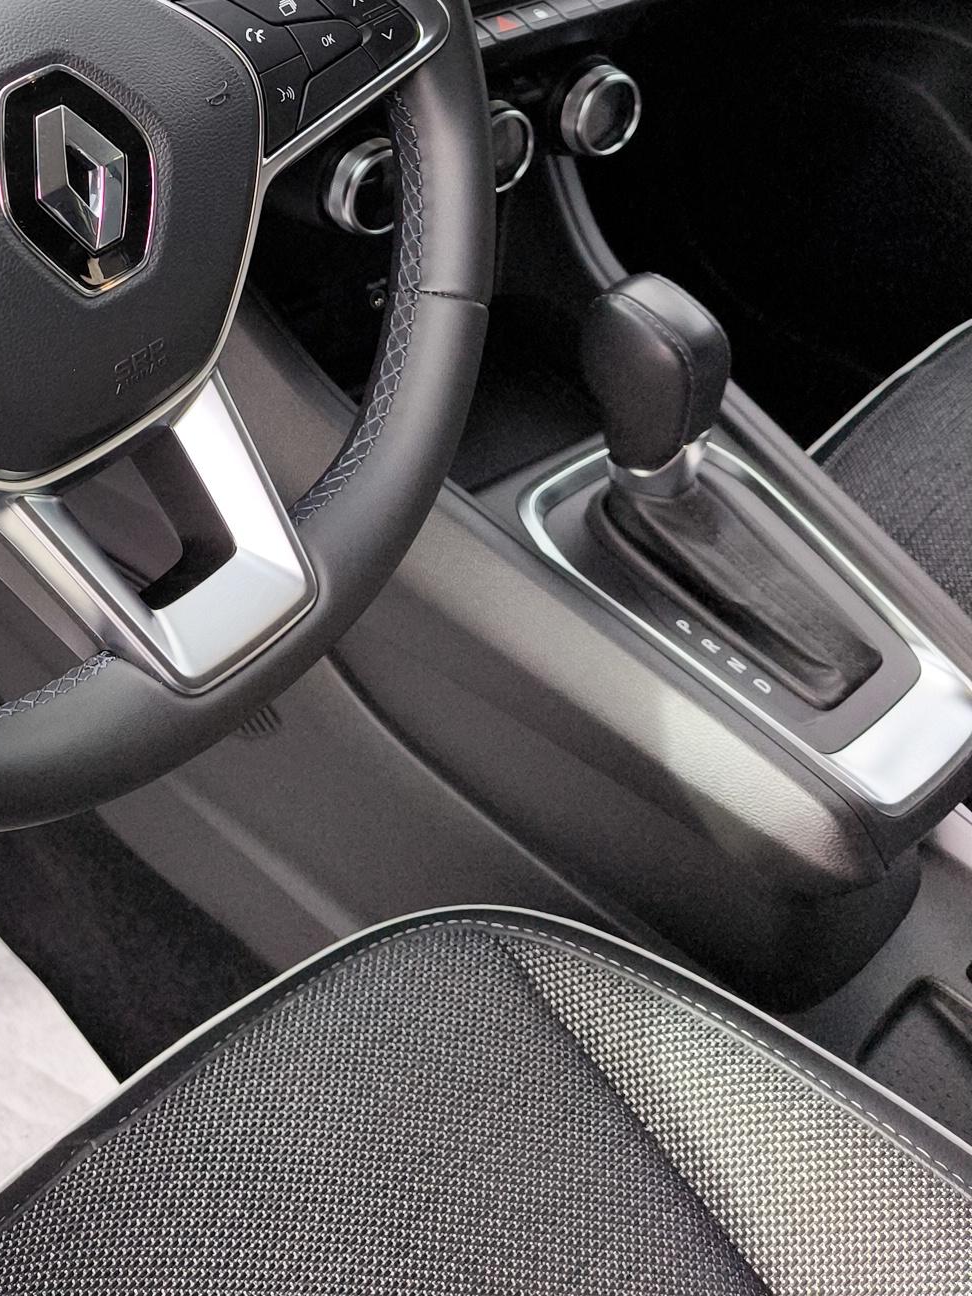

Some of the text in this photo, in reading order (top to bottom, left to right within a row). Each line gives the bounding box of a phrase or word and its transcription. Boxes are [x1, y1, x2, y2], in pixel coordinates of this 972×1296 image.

[321, 33, 337, 48] OK
[675, 619, 772, 695] P R N D
